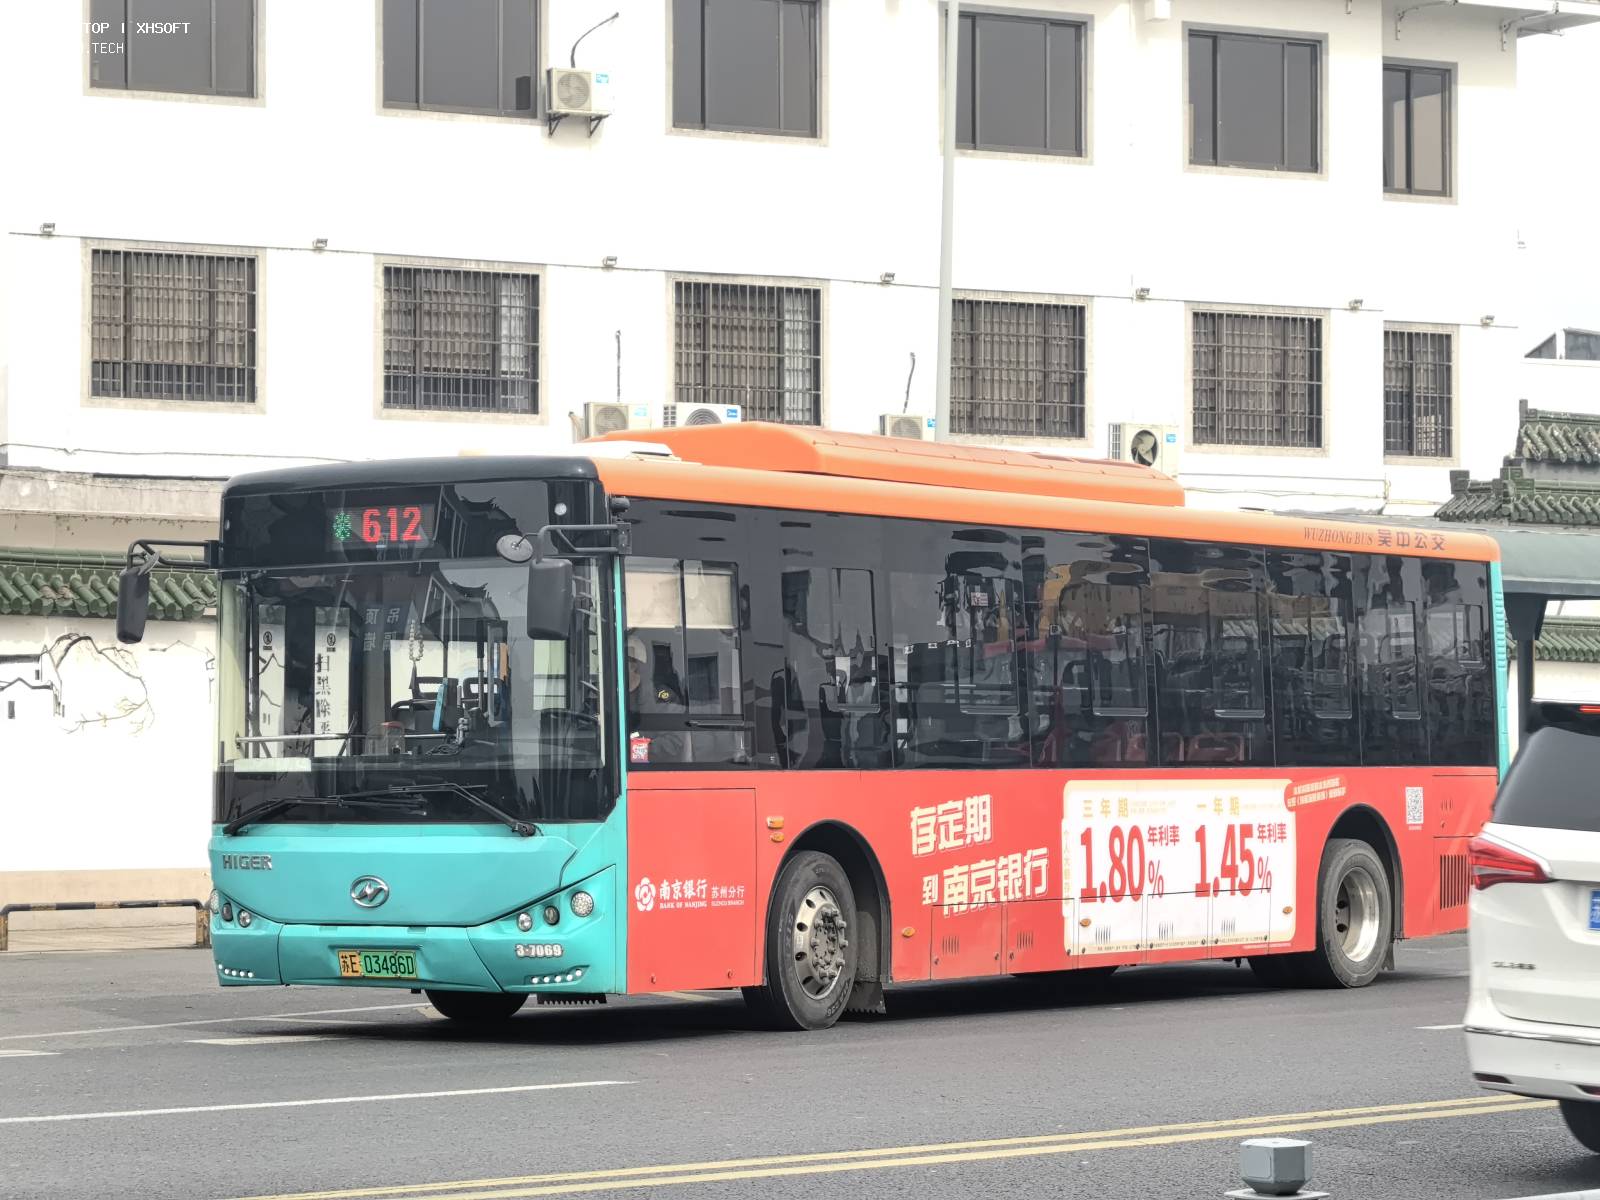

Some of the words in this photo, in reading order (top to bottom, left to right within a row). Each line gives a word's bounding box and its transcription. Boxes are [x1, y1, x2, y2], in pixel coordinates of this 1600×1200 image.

[362, 506, 422, 543] 612
[1304, 527, 1352, 544] WUZHONG
[1354, 528, 1373, 545] BUS
[1377, 528, 1446, 551] 吴中公交
[1083, 797, 1129, 818] 三年期
[1196, 797, 1240, 816] 一年期
[909, 794, 992, 857] 存定期
[1147, 824, 1180, 846] 年利率
[1257, 822, 1287, 843] 年利率
[222, 855, 273, 871] HIGER
[711, 885, 745, 899] 苏州分行
